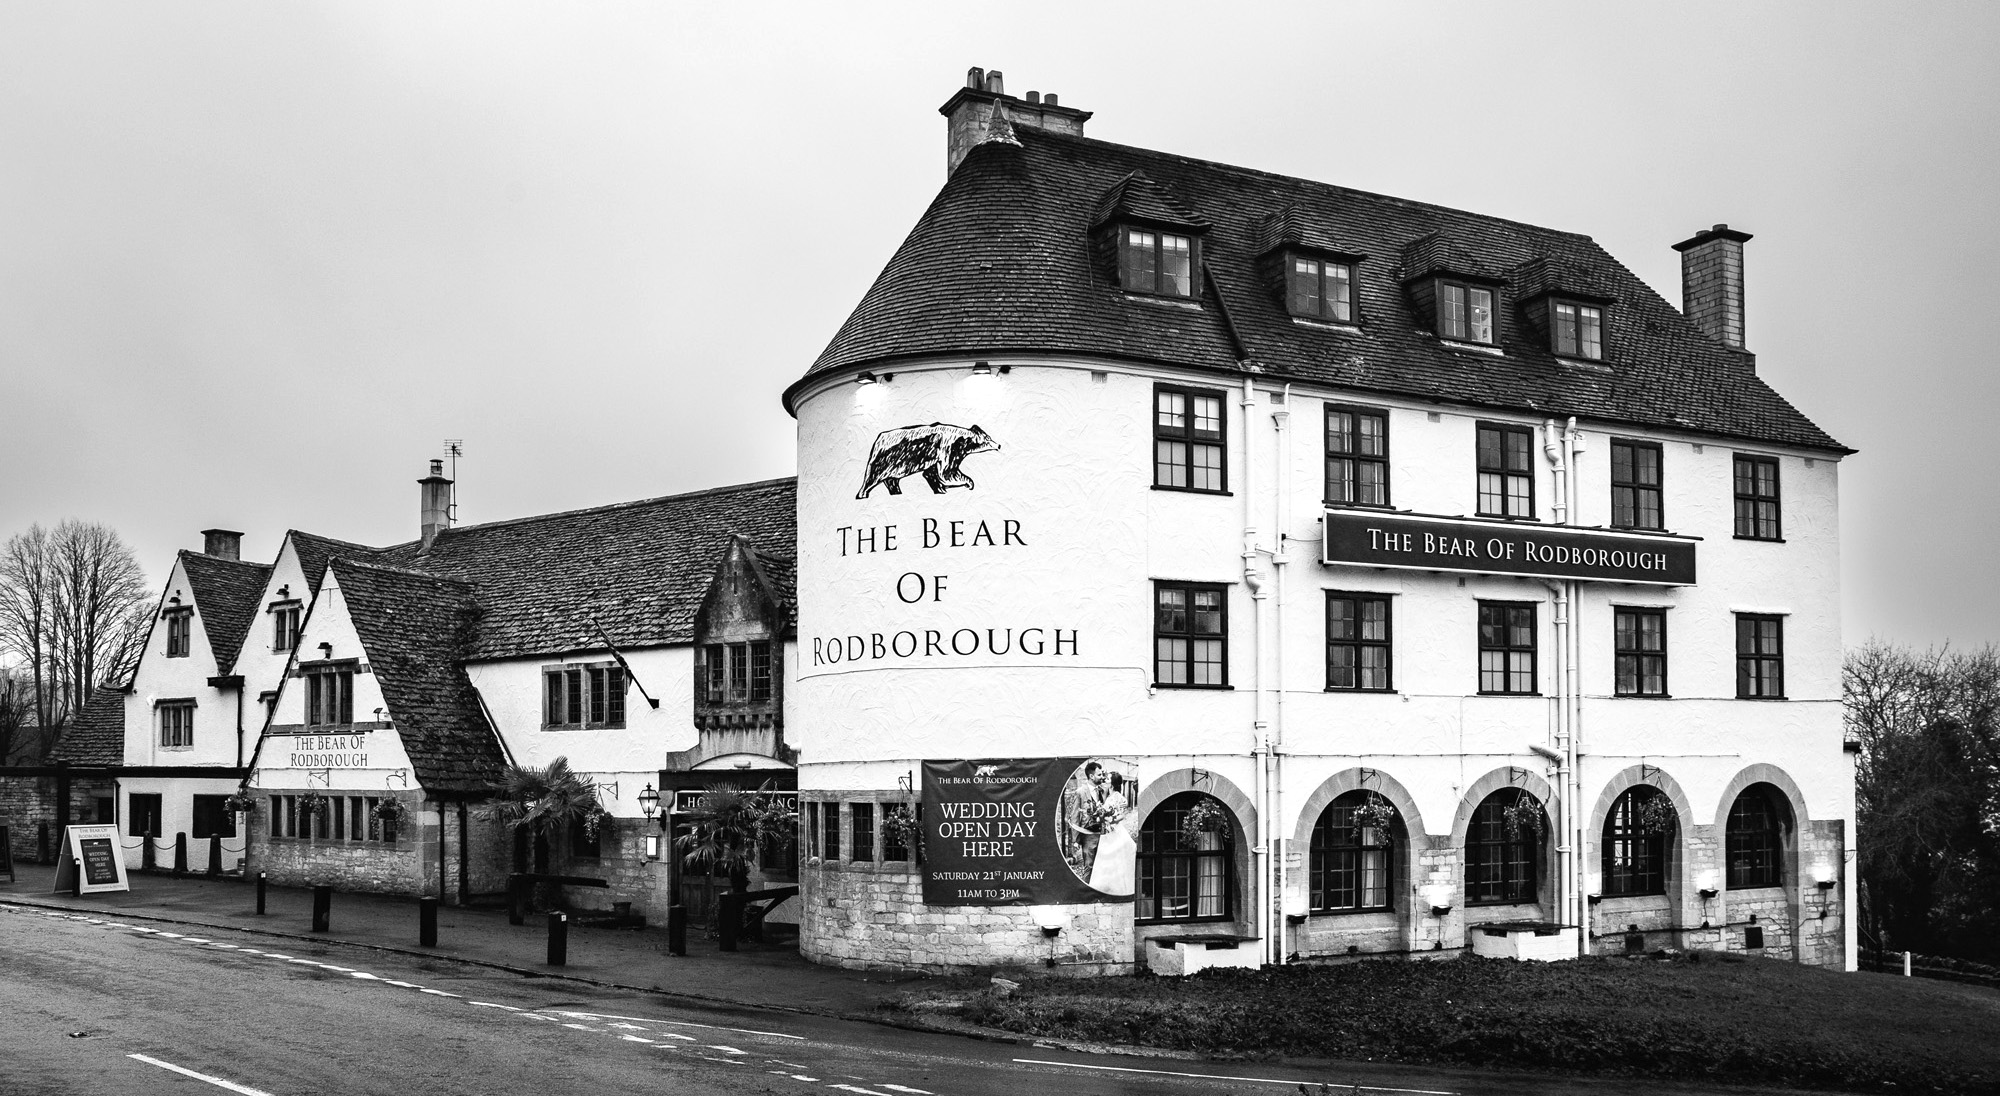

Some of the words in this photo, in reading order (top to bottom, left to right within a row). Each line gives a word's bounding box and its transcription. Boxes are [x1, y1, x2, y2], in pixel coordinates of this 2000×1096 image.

[836, 525, 898, 557] THE
[921, 517, 1028, 549] BEAR
[1366, 528, 1412, 552] THE
[1423, 532, 1478, 558] BEAR
[1486, 538, 1515, 560] OF
[1525, 541, 1668, 571] RODBOROUGH
[896, 572, 948, 604] OF
[813, 628, 1079, 667] RODBOROUGH
[294, 736, 315, 751] THE
[317, 735, 347, 750] BEAR
[350, 734, 366, 750] OF
[290, 752, 368, 767] RODBOROUGH
[937, 776, 951, 785] THE
[953, 776, 972, 785] BEAR
[973, 776, 985, 784] OF
[985, 776, 1038, 785] RODBOROUGH
[939, 802, 1036, 819] WEDDING
[938, 822, 991, 839] OPEN
[997, 821, 1038, 838] DAY
[962, 841, 1015, 858] HERE
[932, 871, 980, 881] SATURDAY
[1003, 871, 1046, 881] JANUARY
[957, 889, 983, 898] 11AM
[984, 889, 998, 898] TO
[999, 888, 1021, 900] 3PM
